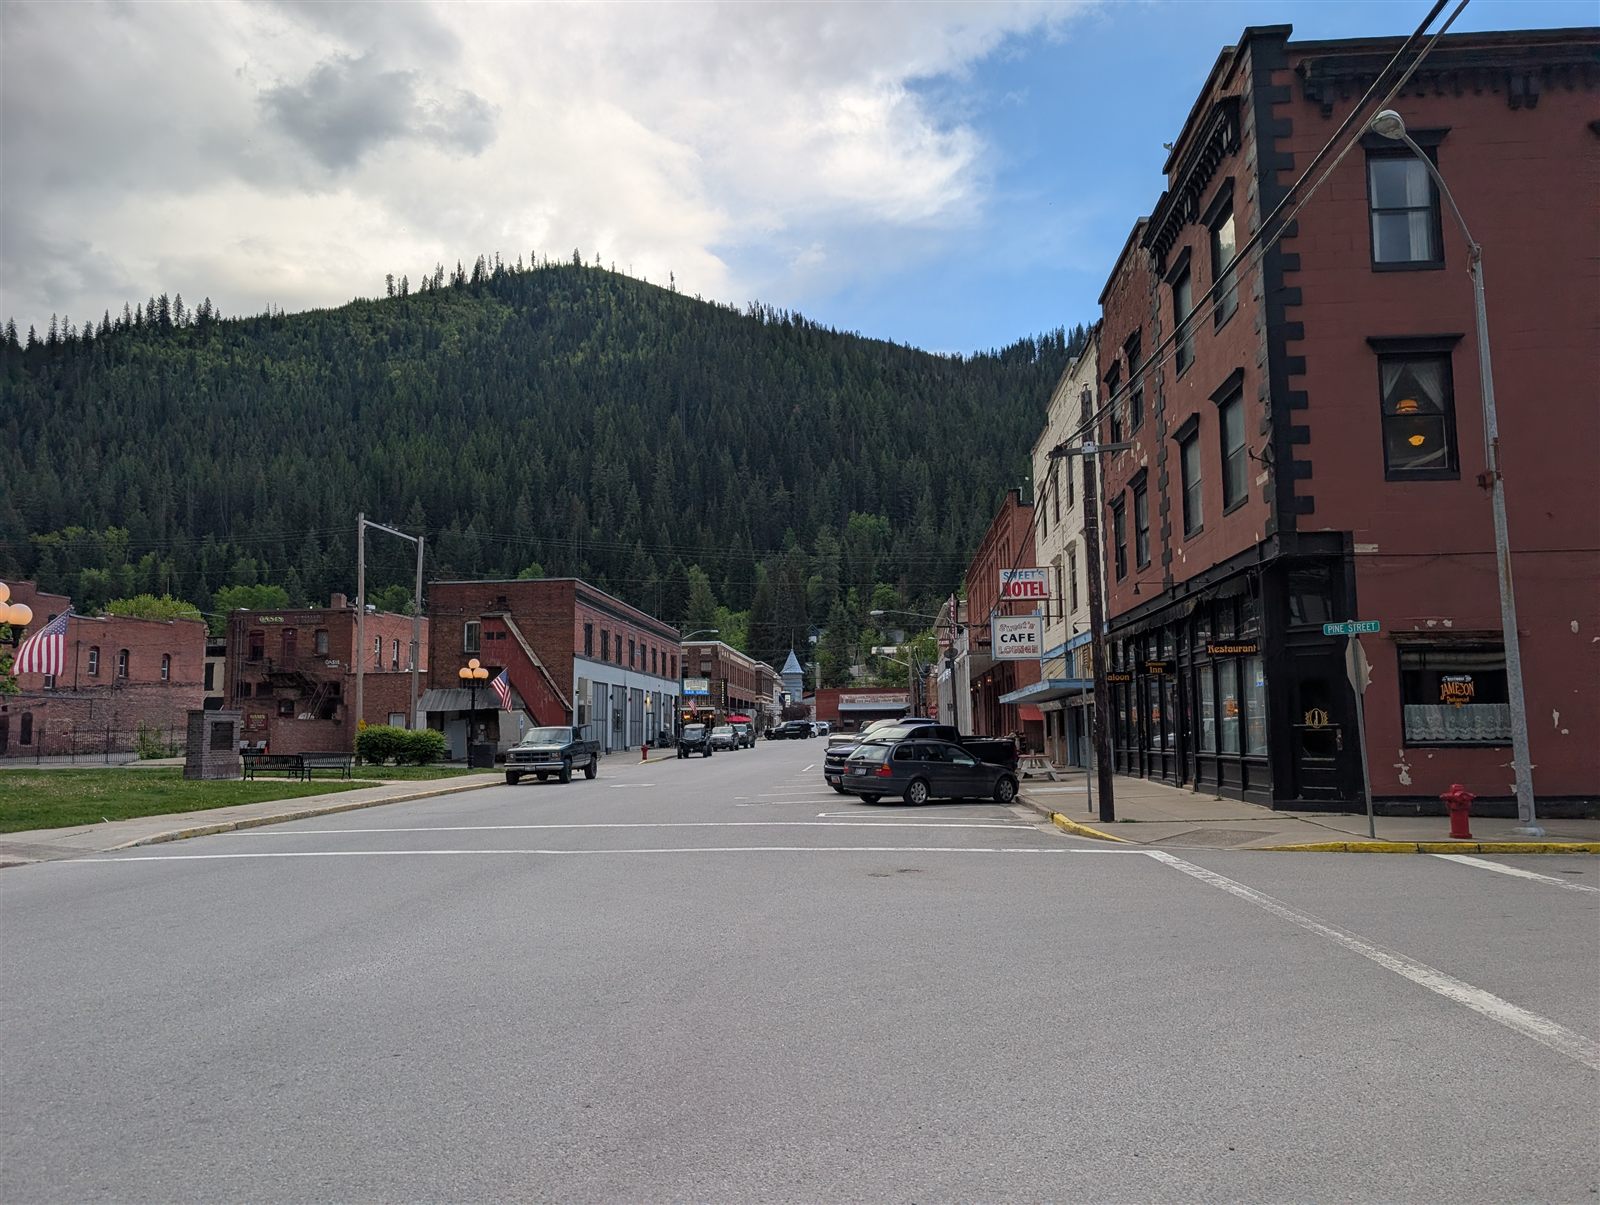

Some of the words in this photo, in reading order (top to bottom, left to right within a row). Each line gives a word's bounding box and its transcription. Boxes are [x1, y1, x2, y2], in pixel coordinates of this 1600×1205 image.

[1002, 581, 1047, 597] HOTEL
[1327, 624, 1345, 634] PINE
[1347, 622, 1376, 633] STREET
[1000, 633, 1036, 643] CAFE
[1207, 644, 1257, 654] Restaurant
[1440, 681, 1475, 701] JAMESON
